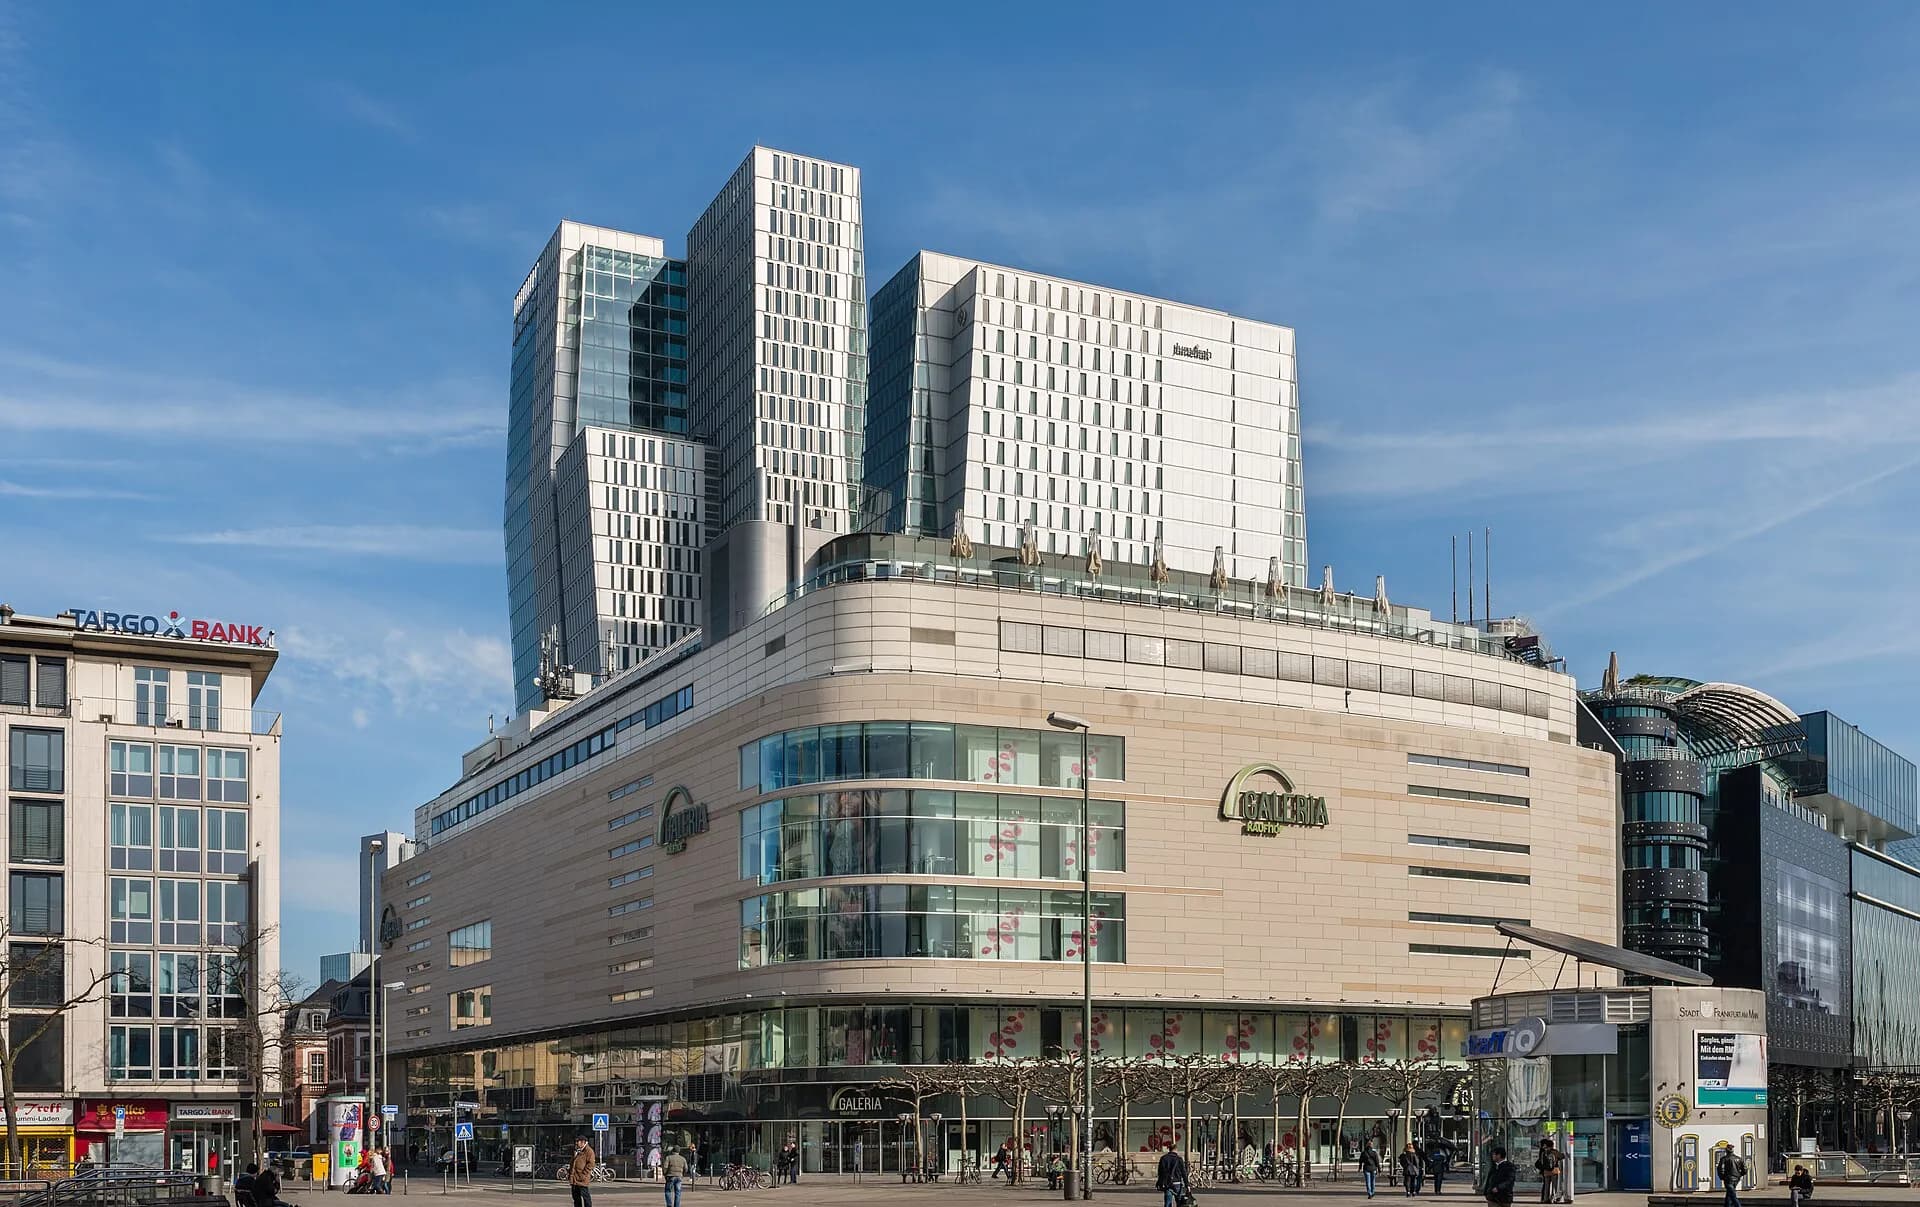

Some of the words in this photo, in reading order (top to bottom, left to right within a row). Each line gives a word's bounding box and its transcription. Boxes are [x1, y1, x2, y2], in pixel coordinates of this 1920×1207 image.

[69, 608, 159, 635] TARGO
[191, 620, 265, 645] BANK
[1243, 790, 1330, 826] GALERIA
[838, 1096, 882, 1111] GALERIA
